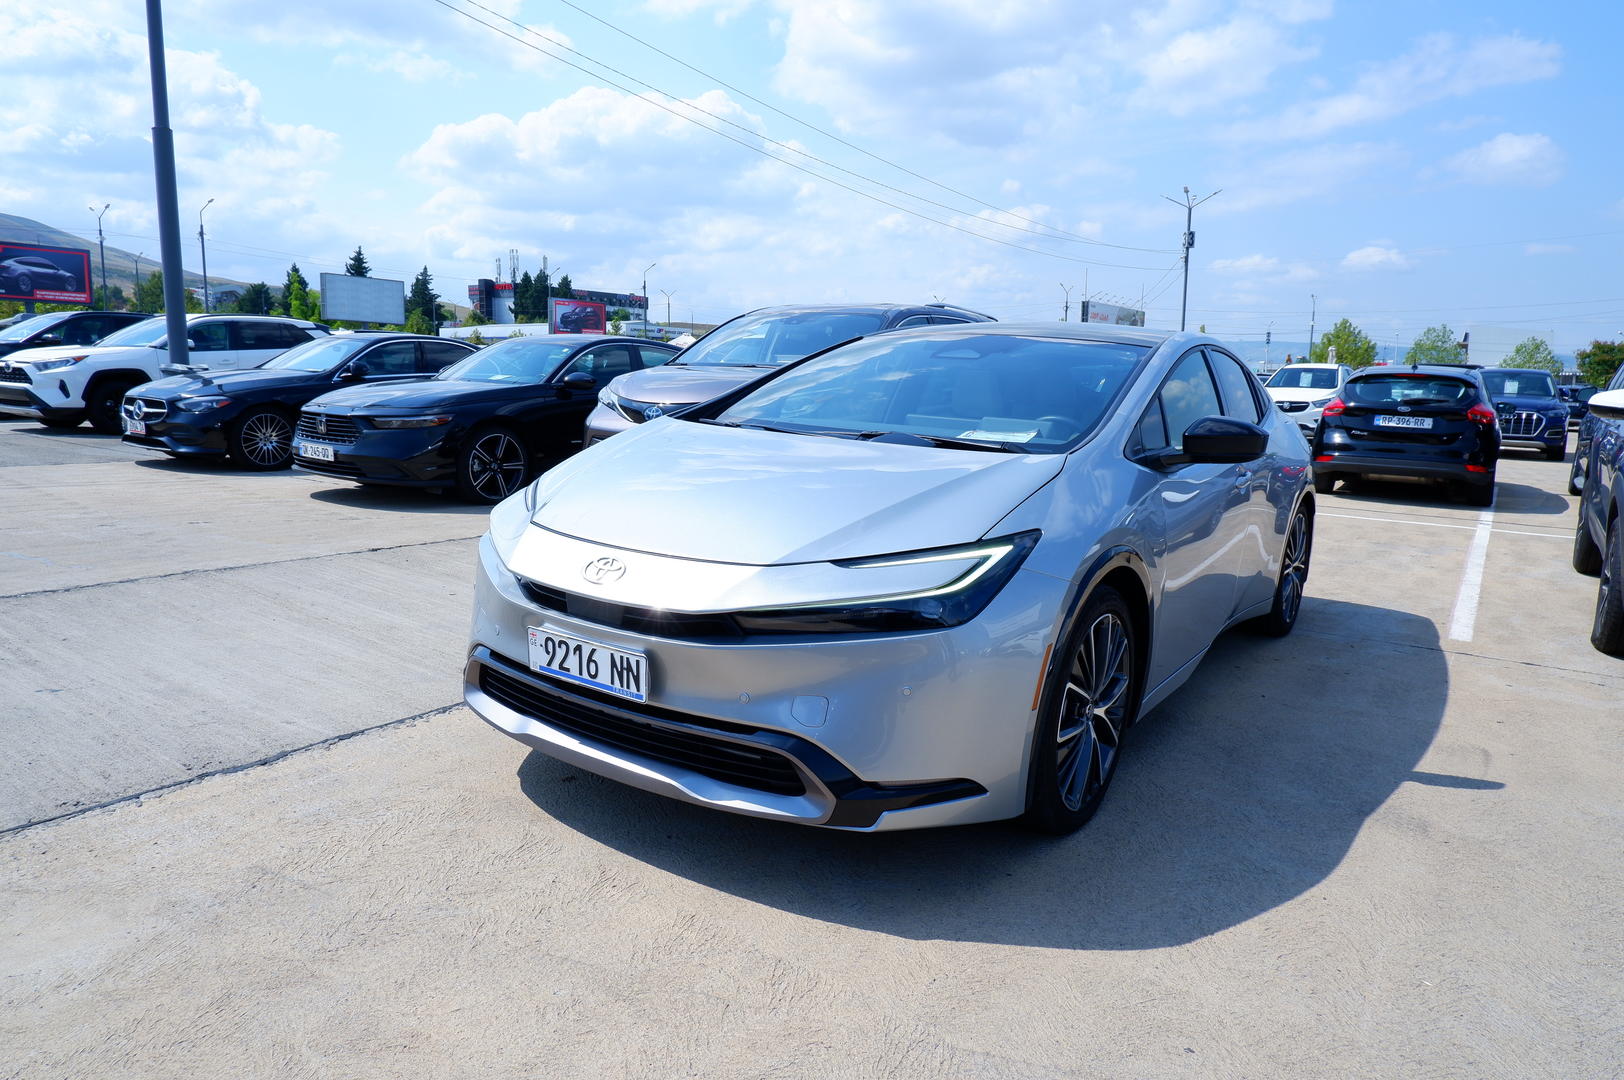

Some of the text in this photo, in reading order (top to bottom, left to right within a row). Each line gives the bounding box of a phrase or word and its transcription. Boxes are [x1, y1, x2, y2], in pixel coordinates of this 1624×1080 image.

[1381, 416, 1425, 427] RP-396-RR
[544, 636, 640, 693] 9216 NN
